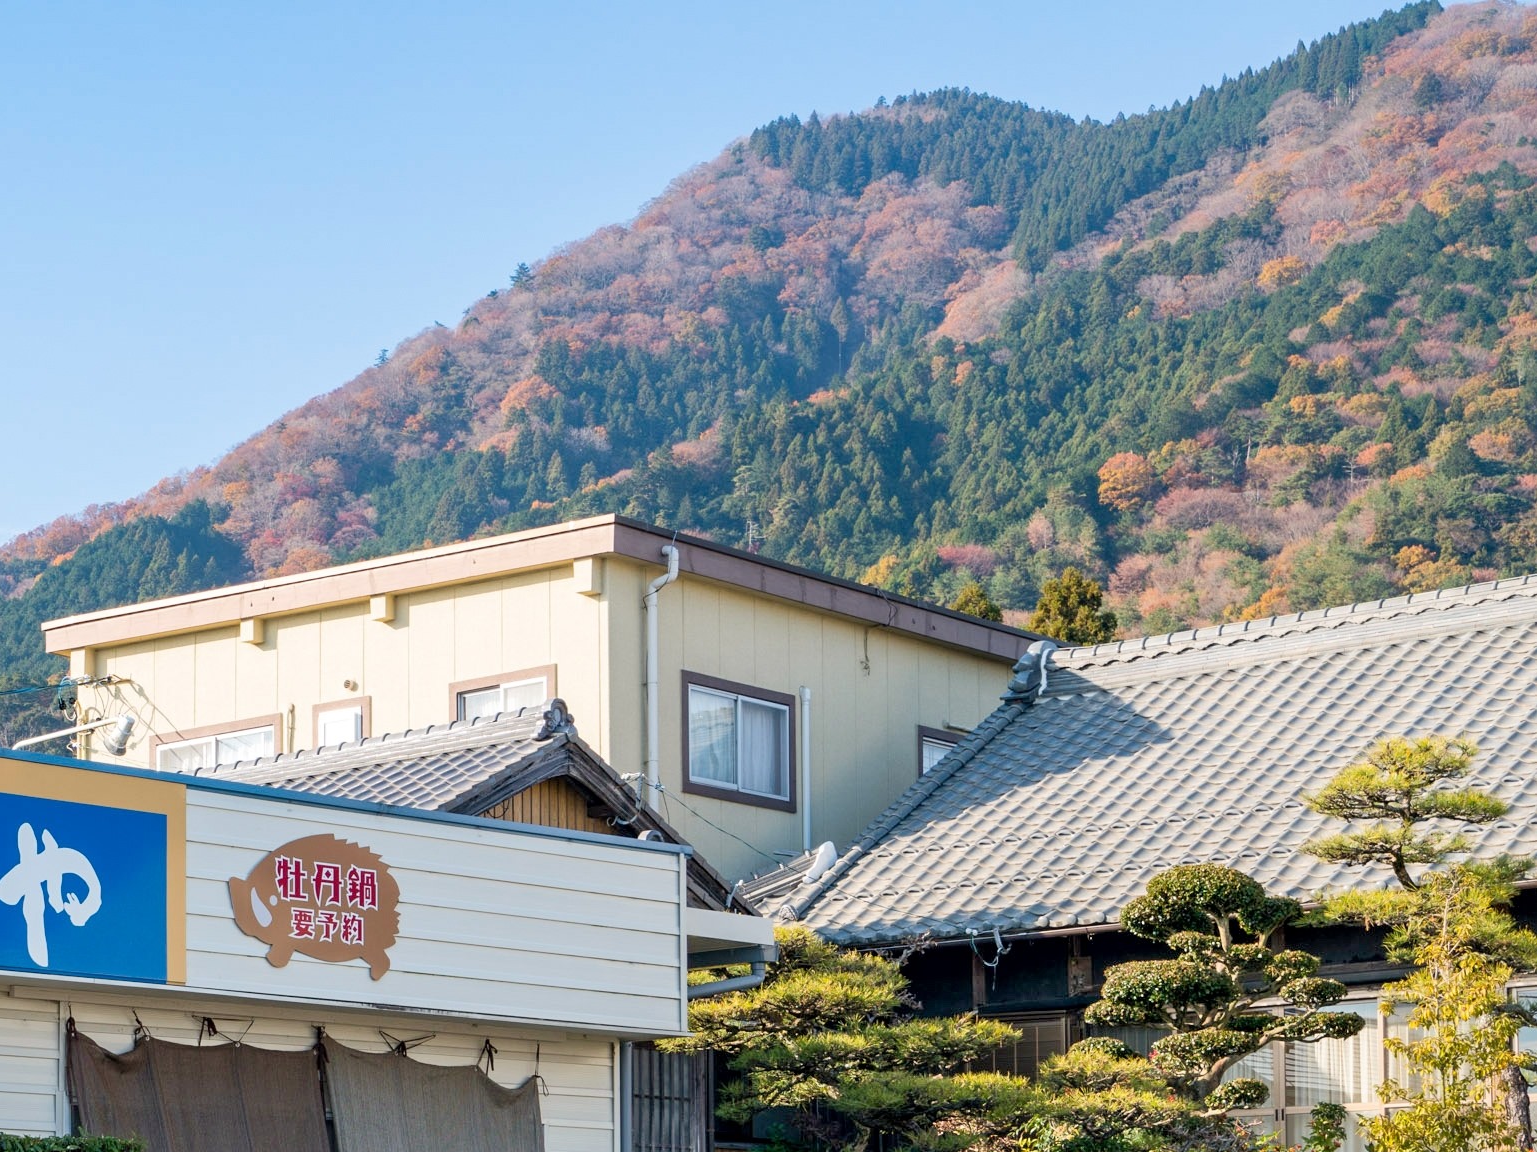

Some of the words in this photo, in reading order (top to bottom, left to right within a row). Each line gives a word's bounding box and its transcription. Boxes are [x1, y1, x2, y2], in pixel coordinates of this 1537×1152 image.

[274, 855, 380, 913] 牡丹鍋
[290, 908, 365, 946] 要予約
